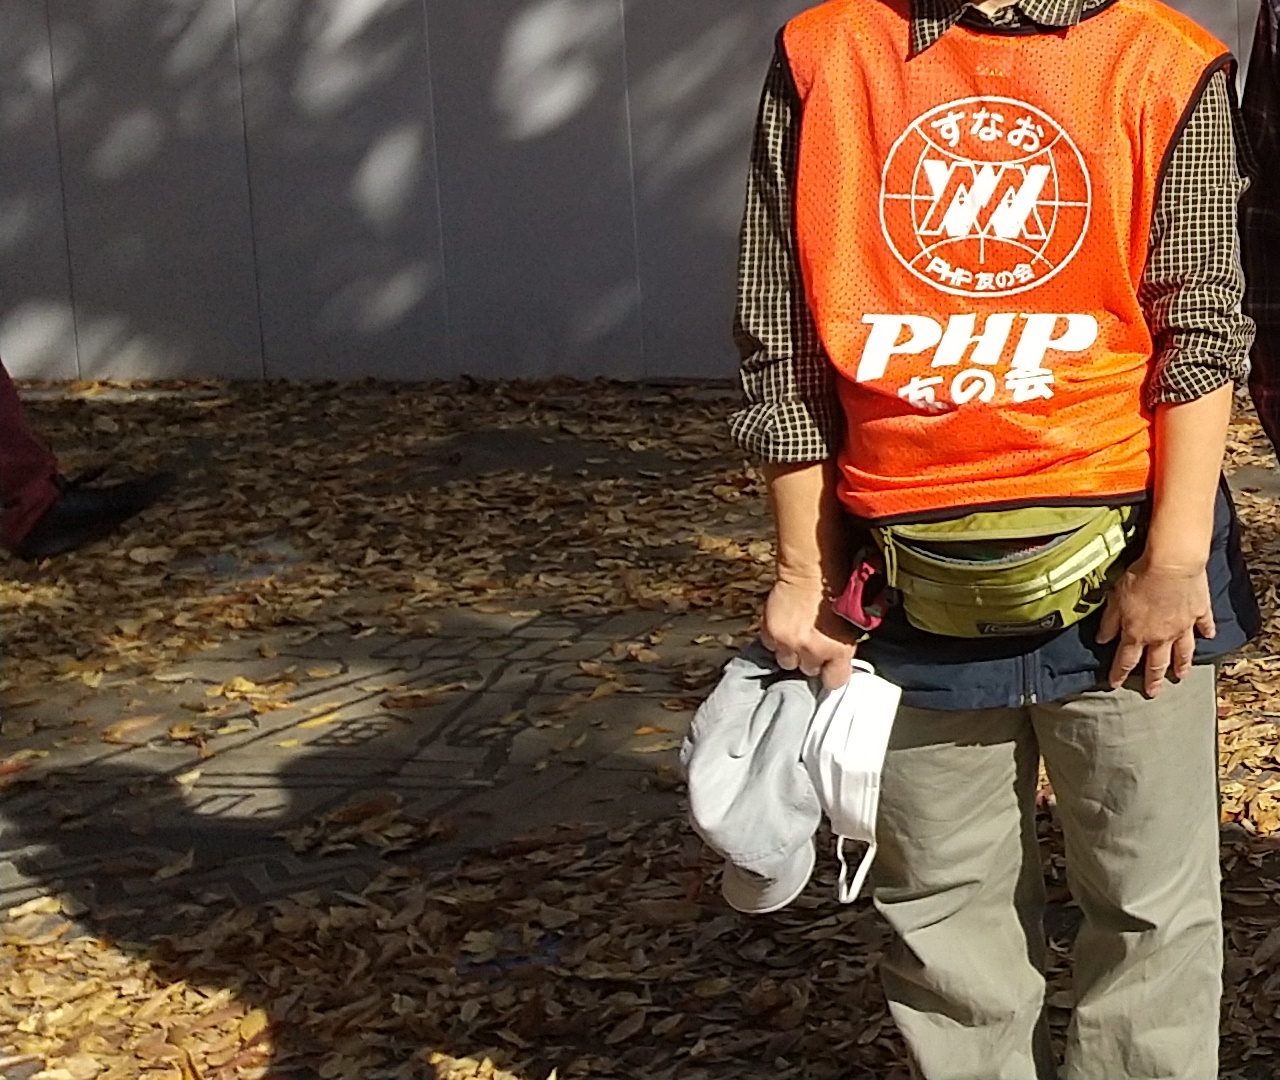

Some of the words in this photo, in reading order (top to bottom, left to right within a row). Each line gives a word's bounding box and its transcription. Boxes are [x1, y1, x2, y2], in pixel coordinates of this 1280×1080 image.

[931, 107, 1045, 152] すなお
[856, 312, 1099, 383] PHP
[898, 366, 1056, 410] 友の会
